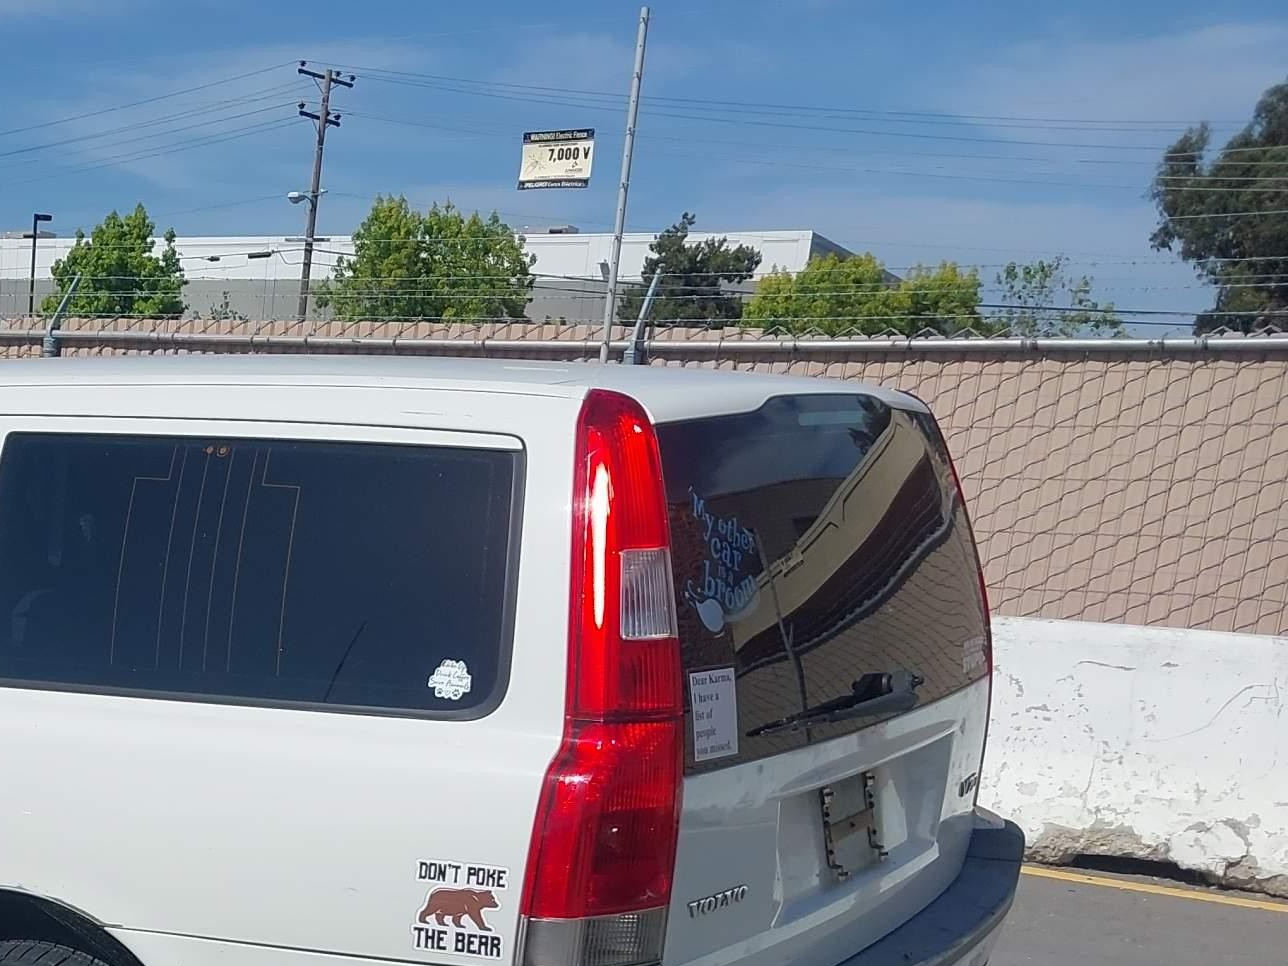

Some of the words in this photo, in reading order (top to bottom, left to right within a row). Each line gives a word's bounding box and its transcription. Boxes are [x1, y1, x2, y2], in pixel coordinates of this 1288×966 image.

[548, 147, 580, 163] 7,000
[583, 146, 591, 160] V
[692, 492, 714, 541] My
[718, 517, 755, 554] other
[711, 537, 742, 571] car
[704, 560, 756, 608] broom
[692, 676, 707, 686] Dear
[698, 691, 714, 703] have
[715, 692, 719, 701] a
[418, 861, 461, 884] DON'T
[466, 866, 507, 888] POKE
[687, 884, 749, 918] VOLVO
[413, 927, 447, 951] THE
[454, 931, 501, 958] BEAR
